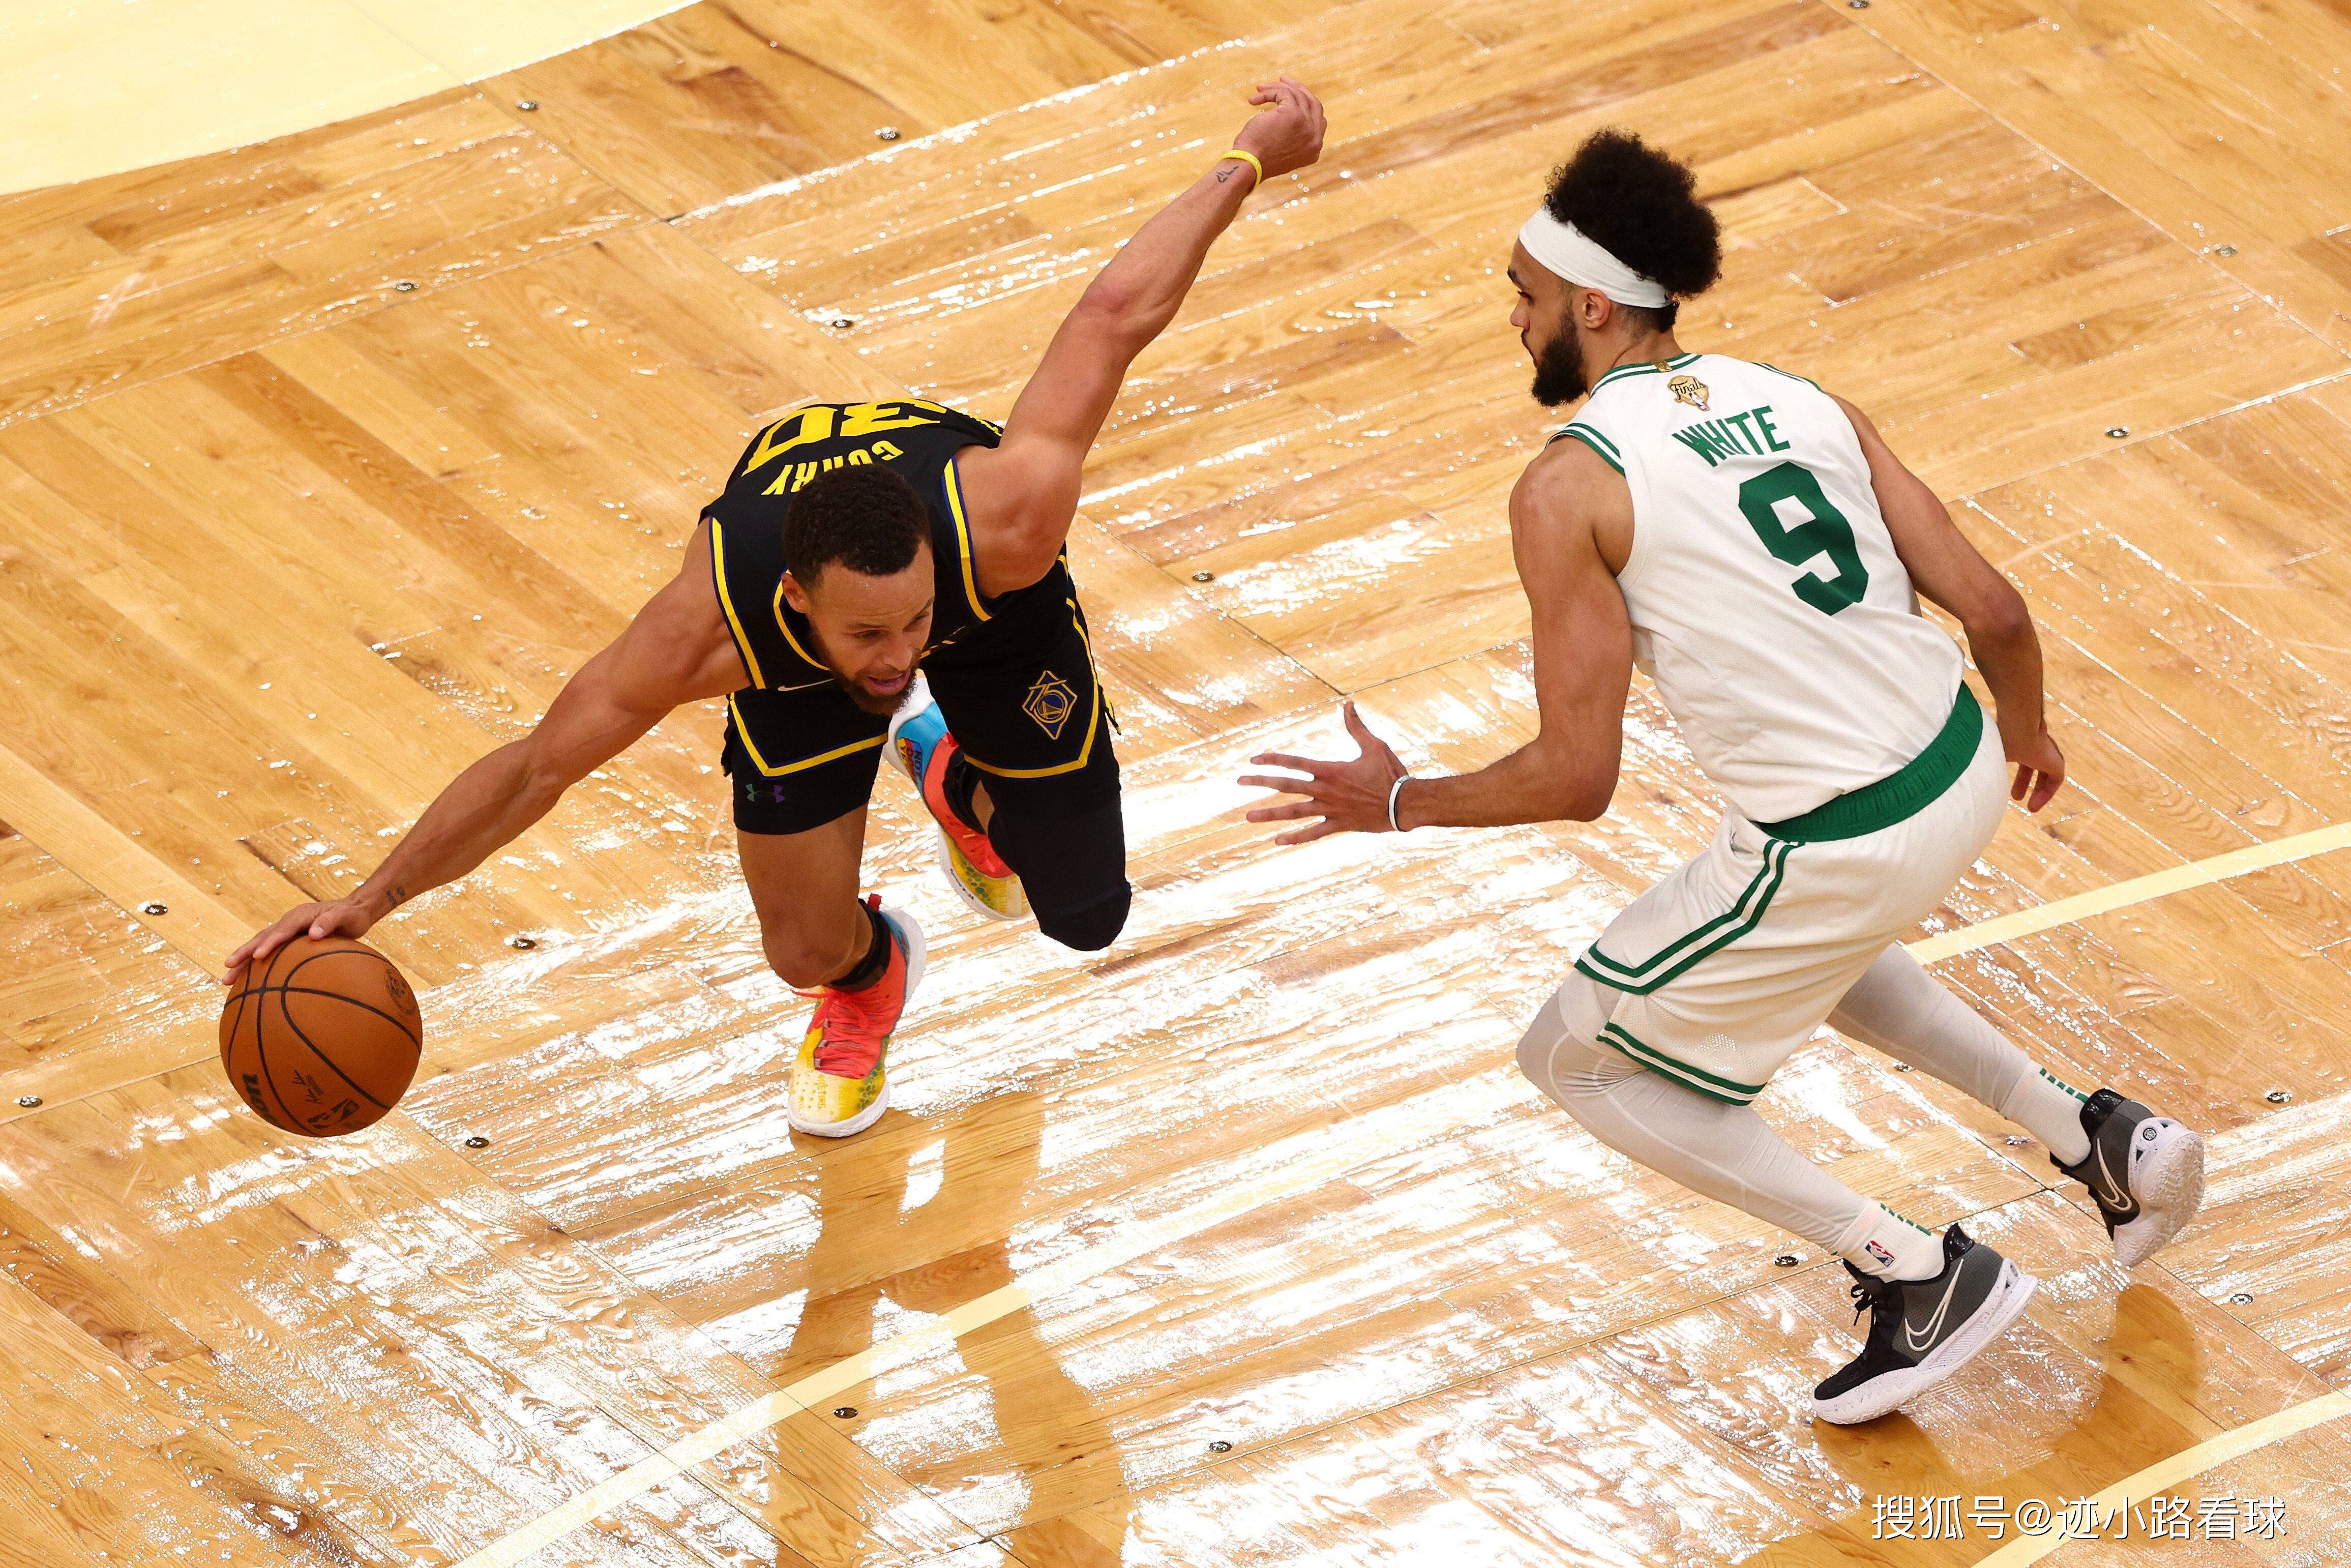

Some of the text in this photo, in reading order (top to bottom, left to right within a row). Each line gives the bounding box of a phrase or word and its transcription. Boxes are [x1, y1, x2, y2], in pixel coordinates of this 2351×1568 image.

[1669, 377, 1706, 401] Finals
[741, 398, 947, 477] 30
[1672, 405, 1791, 467] WHITE
[1738, 461, 1870, 617] 9
